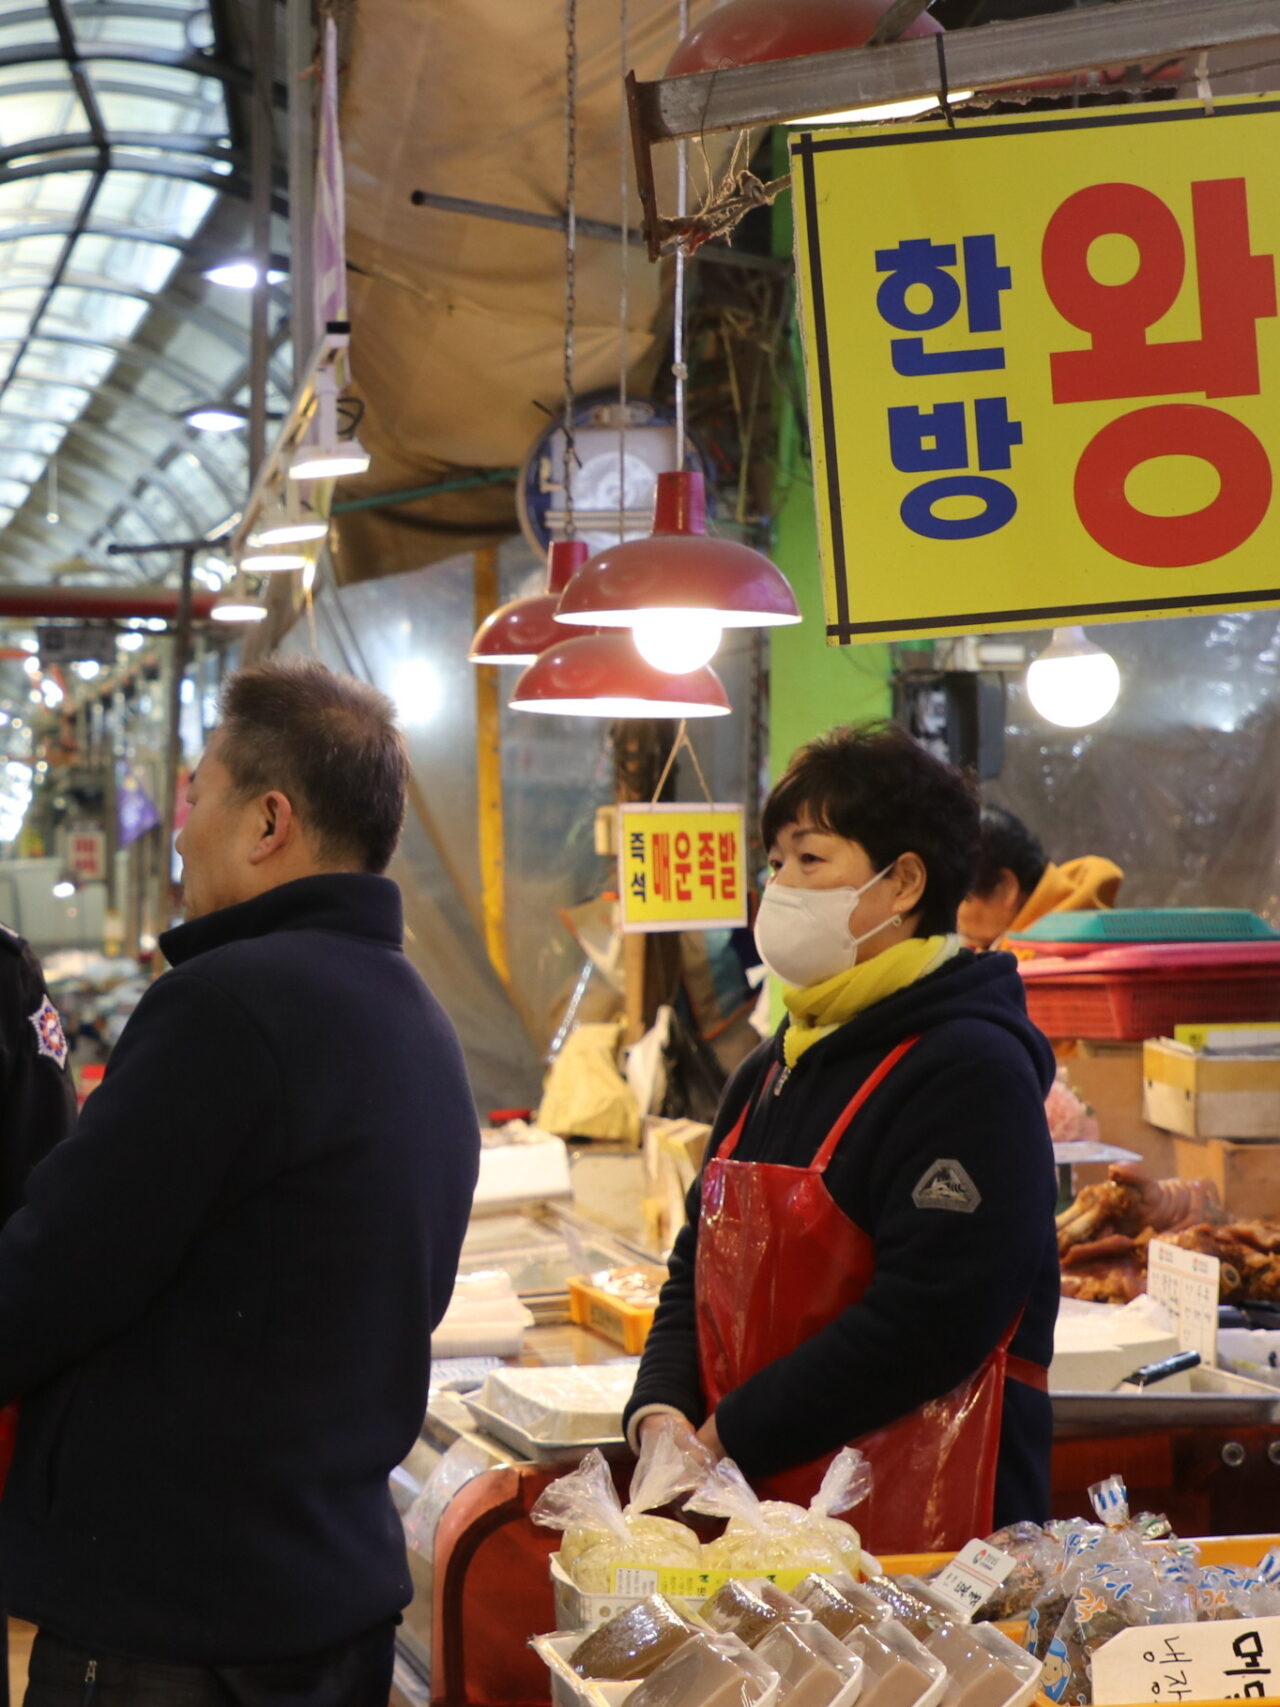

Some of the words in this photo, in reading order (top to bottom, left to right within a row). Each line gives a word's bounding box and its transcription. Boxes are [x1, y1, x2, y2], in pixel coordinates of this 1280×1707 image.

[875, 234, 1022, 540] 한방
[1041, 177, 1278, 568] 왕
[630, 832, 647, 903] 즉석
[652, 831, 737, 902] 매운족발
